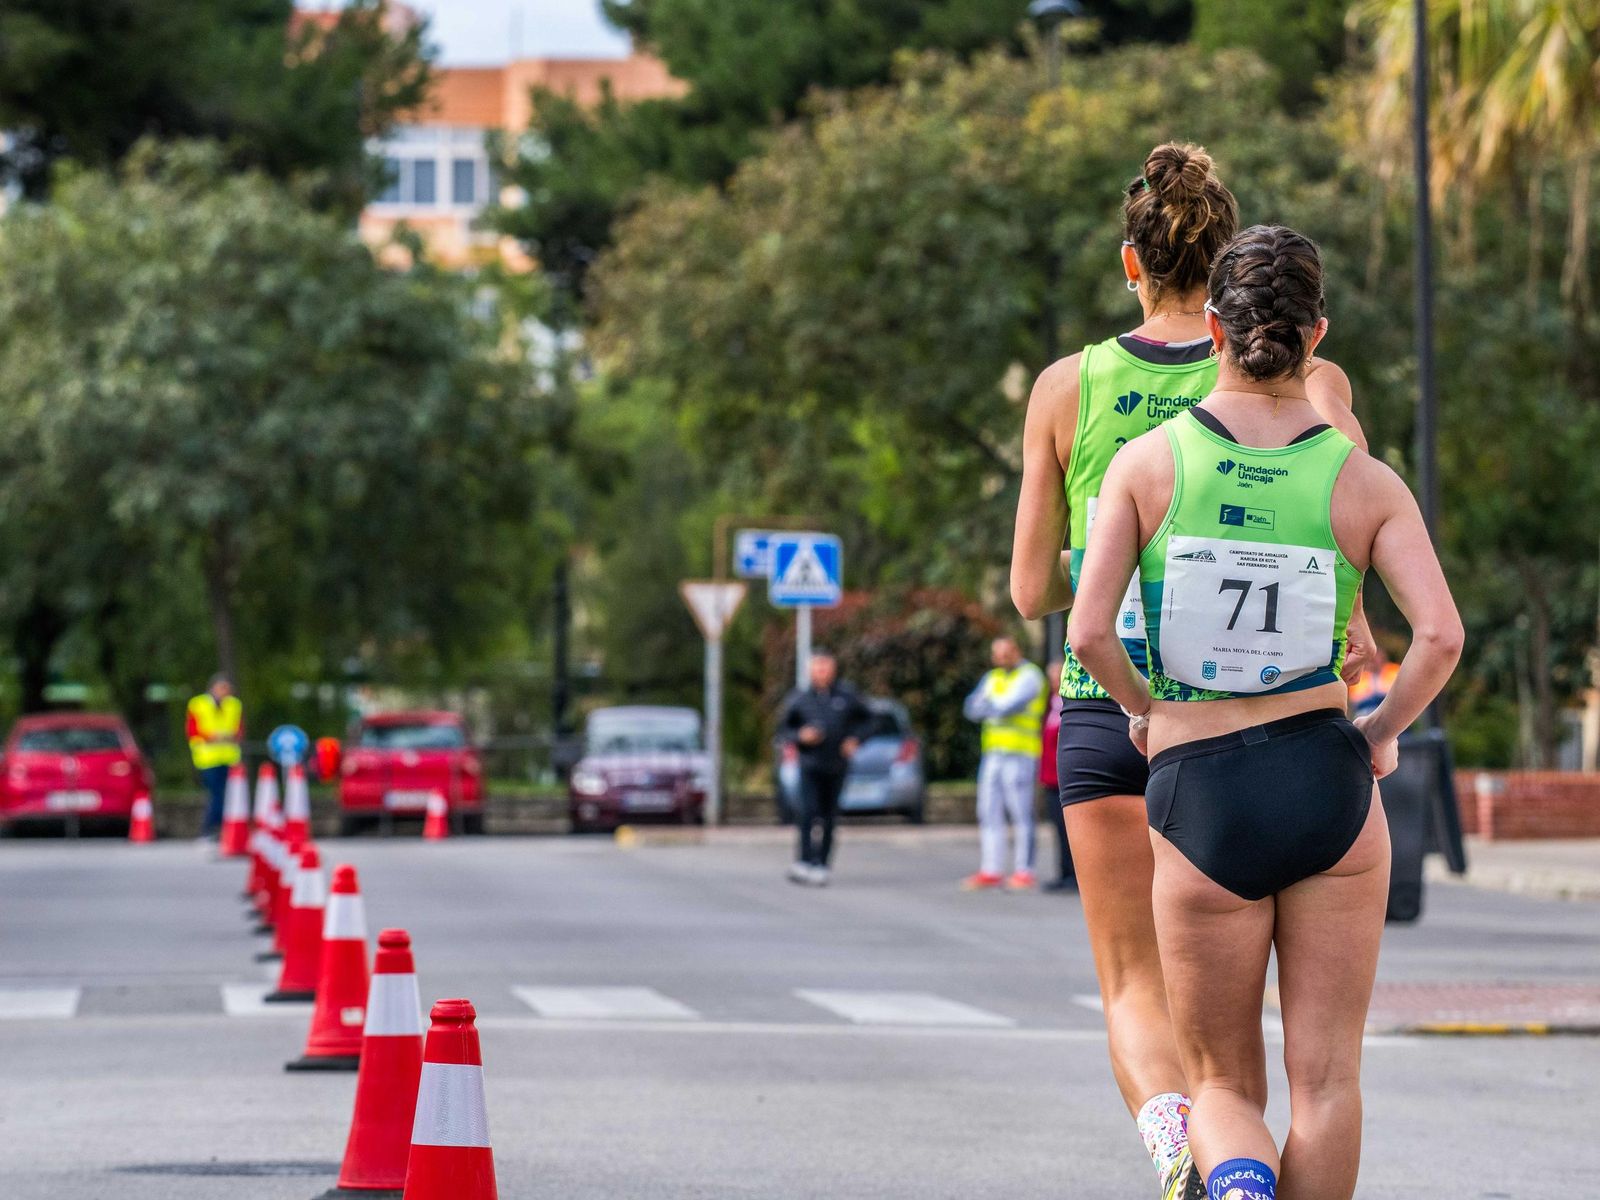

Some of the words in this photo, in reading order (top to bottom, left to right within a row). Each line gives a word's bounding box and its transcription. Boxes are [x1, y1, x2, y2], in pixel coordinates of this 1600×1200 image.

[1147, 393, 1202, 407] Fundaci
[1147, 406, 1179, 419] Unic
[1238, 463, 1288, 476] Fundación
[1238, 471, 1274, 484] Unicaja
[1237, 481, 1253, 489] Jaén
[1218, 578, 1283, 634] 71
